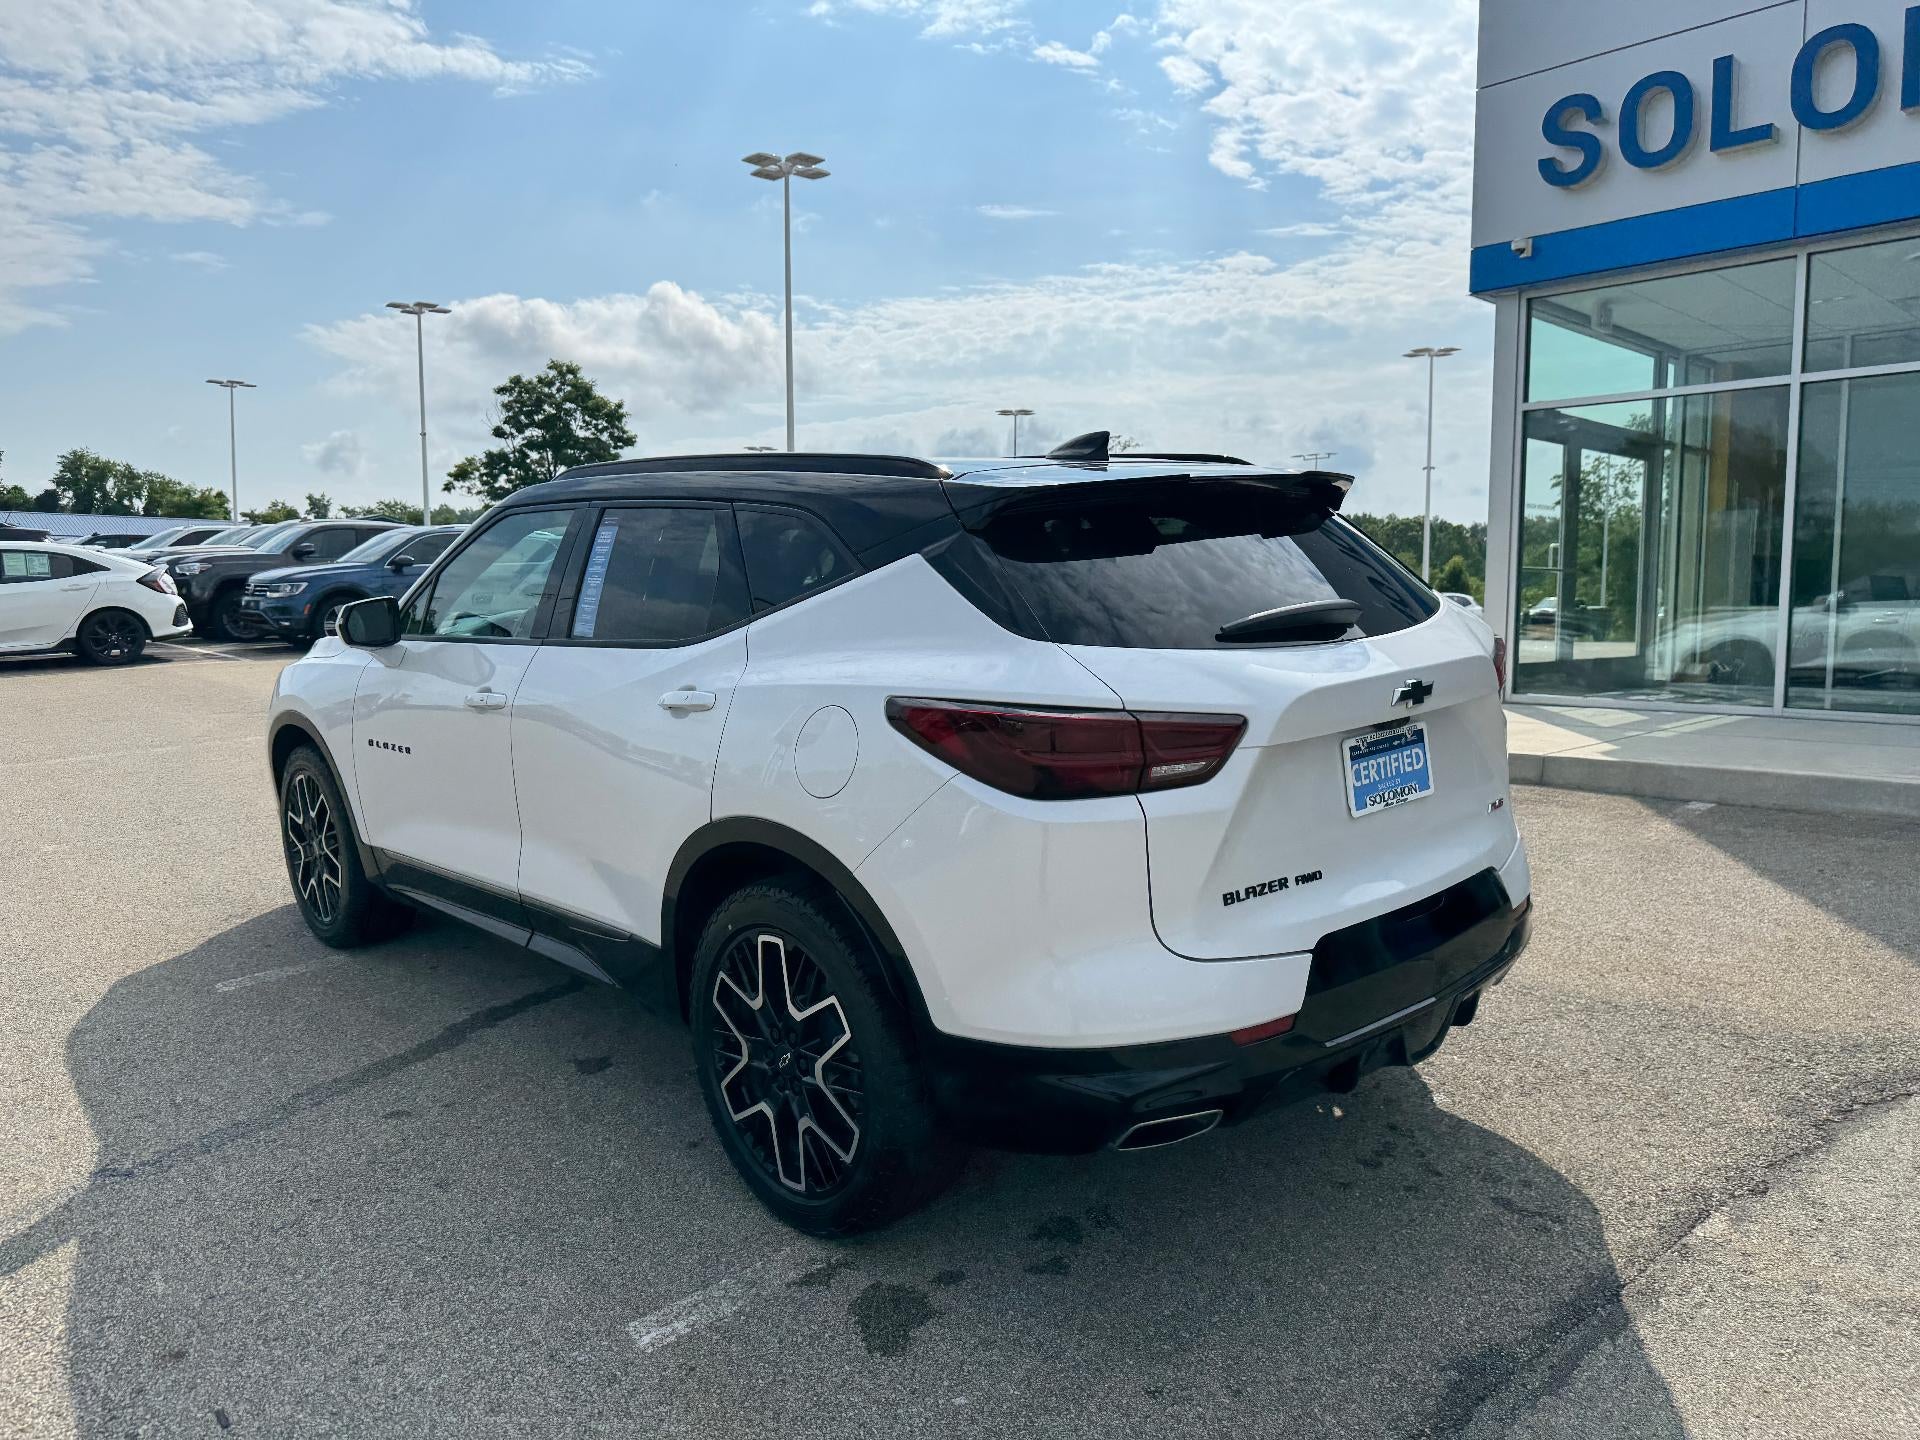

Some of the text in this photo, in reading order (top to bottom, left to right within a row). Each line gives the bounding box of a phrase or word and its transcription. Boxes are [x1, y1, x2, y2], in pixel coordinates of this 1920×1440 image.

[1538, 6, 1920, 188] SOLO
[368, 739, 411, 754] BLAZER
[1351, 749, 1424, 787] CERTIFIED
[1368, 784, 1418, 806] SOLOMON
[1222, 869, 1322, 907] BLAZER AWD
